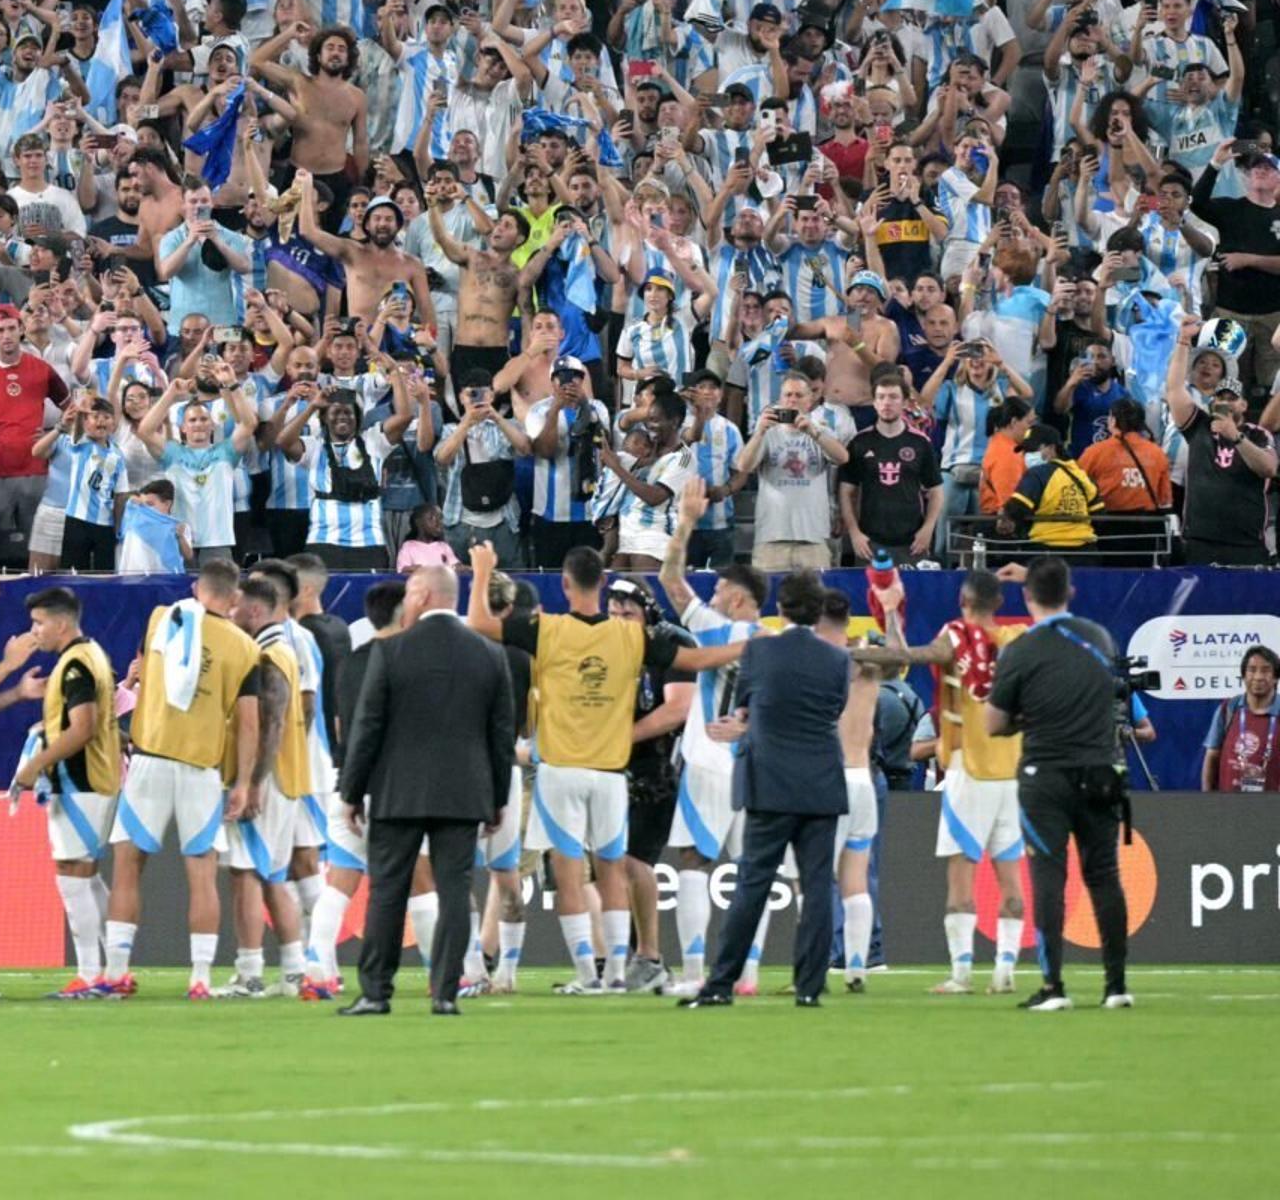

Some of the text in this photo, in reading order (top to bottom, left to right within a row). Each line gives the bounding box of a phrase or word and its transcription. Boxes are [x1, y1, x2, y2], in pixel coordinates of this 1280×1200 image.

[1178, 132, 1208, 151] VISA
[903, 225, 920, 236] LG
[1193, 633, 1261, 645] LATAM
[1193, 650, 1243, 658] AIRLIN
[1195, 676, 1244, 689] DELT
[1192, 863, 1280, 928] pr
